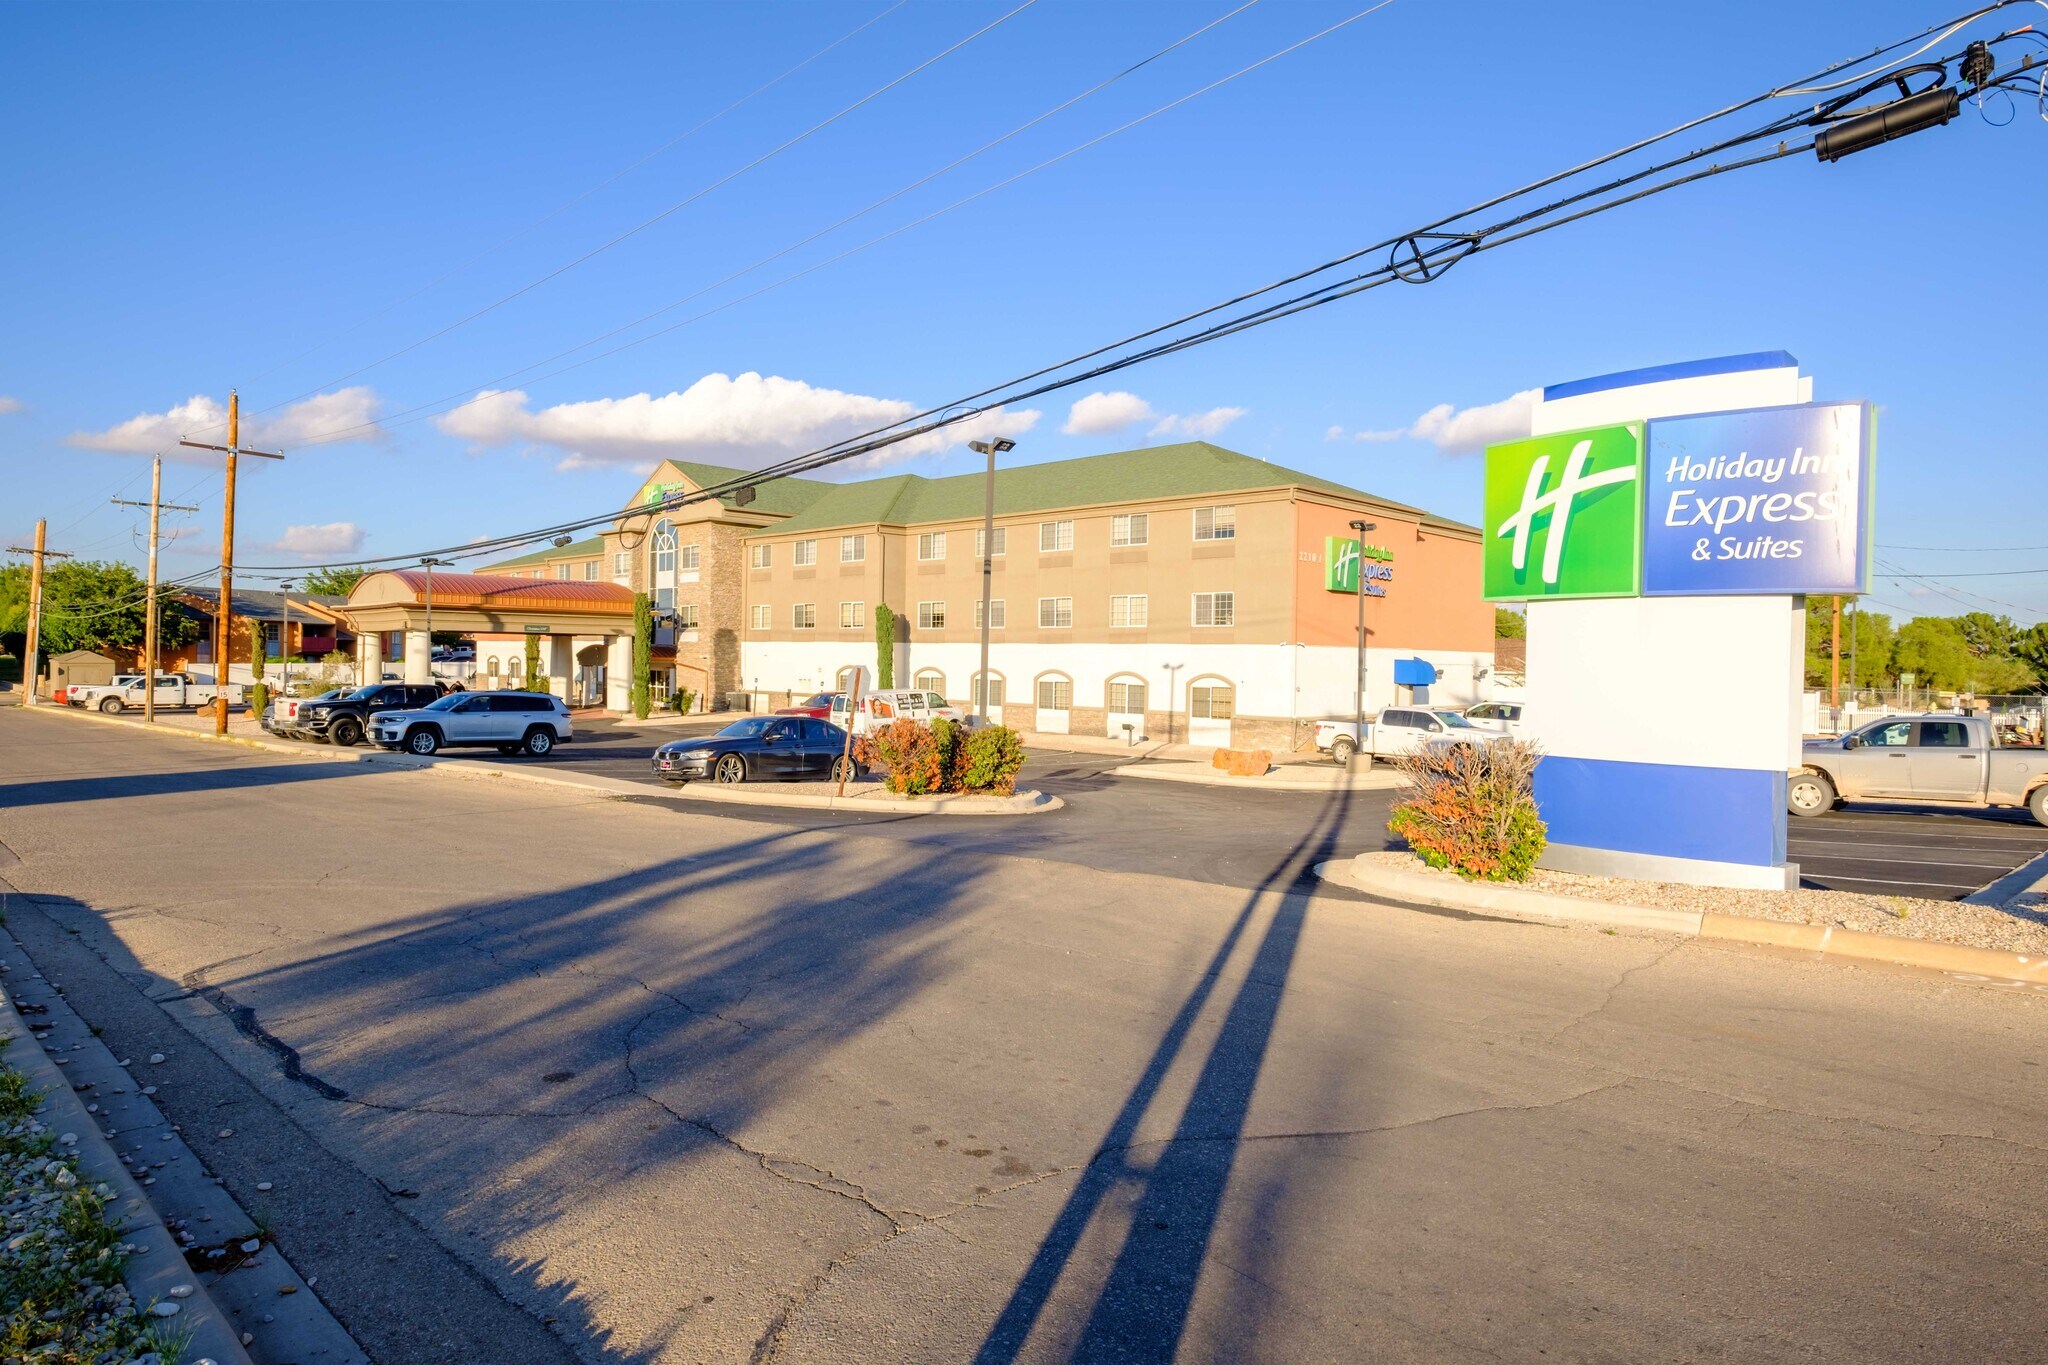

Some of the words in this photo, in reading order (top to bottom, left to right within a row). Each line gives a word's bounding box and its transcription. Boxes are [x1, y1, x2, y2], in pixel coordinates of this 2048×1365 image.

[1665, 451, 1787, 483] Holiday
[1665, 489, 1842, 535] Express
[1691, 537, 1711, 561] &
[1717, 535, 1804, 560] Suites
[1359, 564, 1393, 584] xpress
